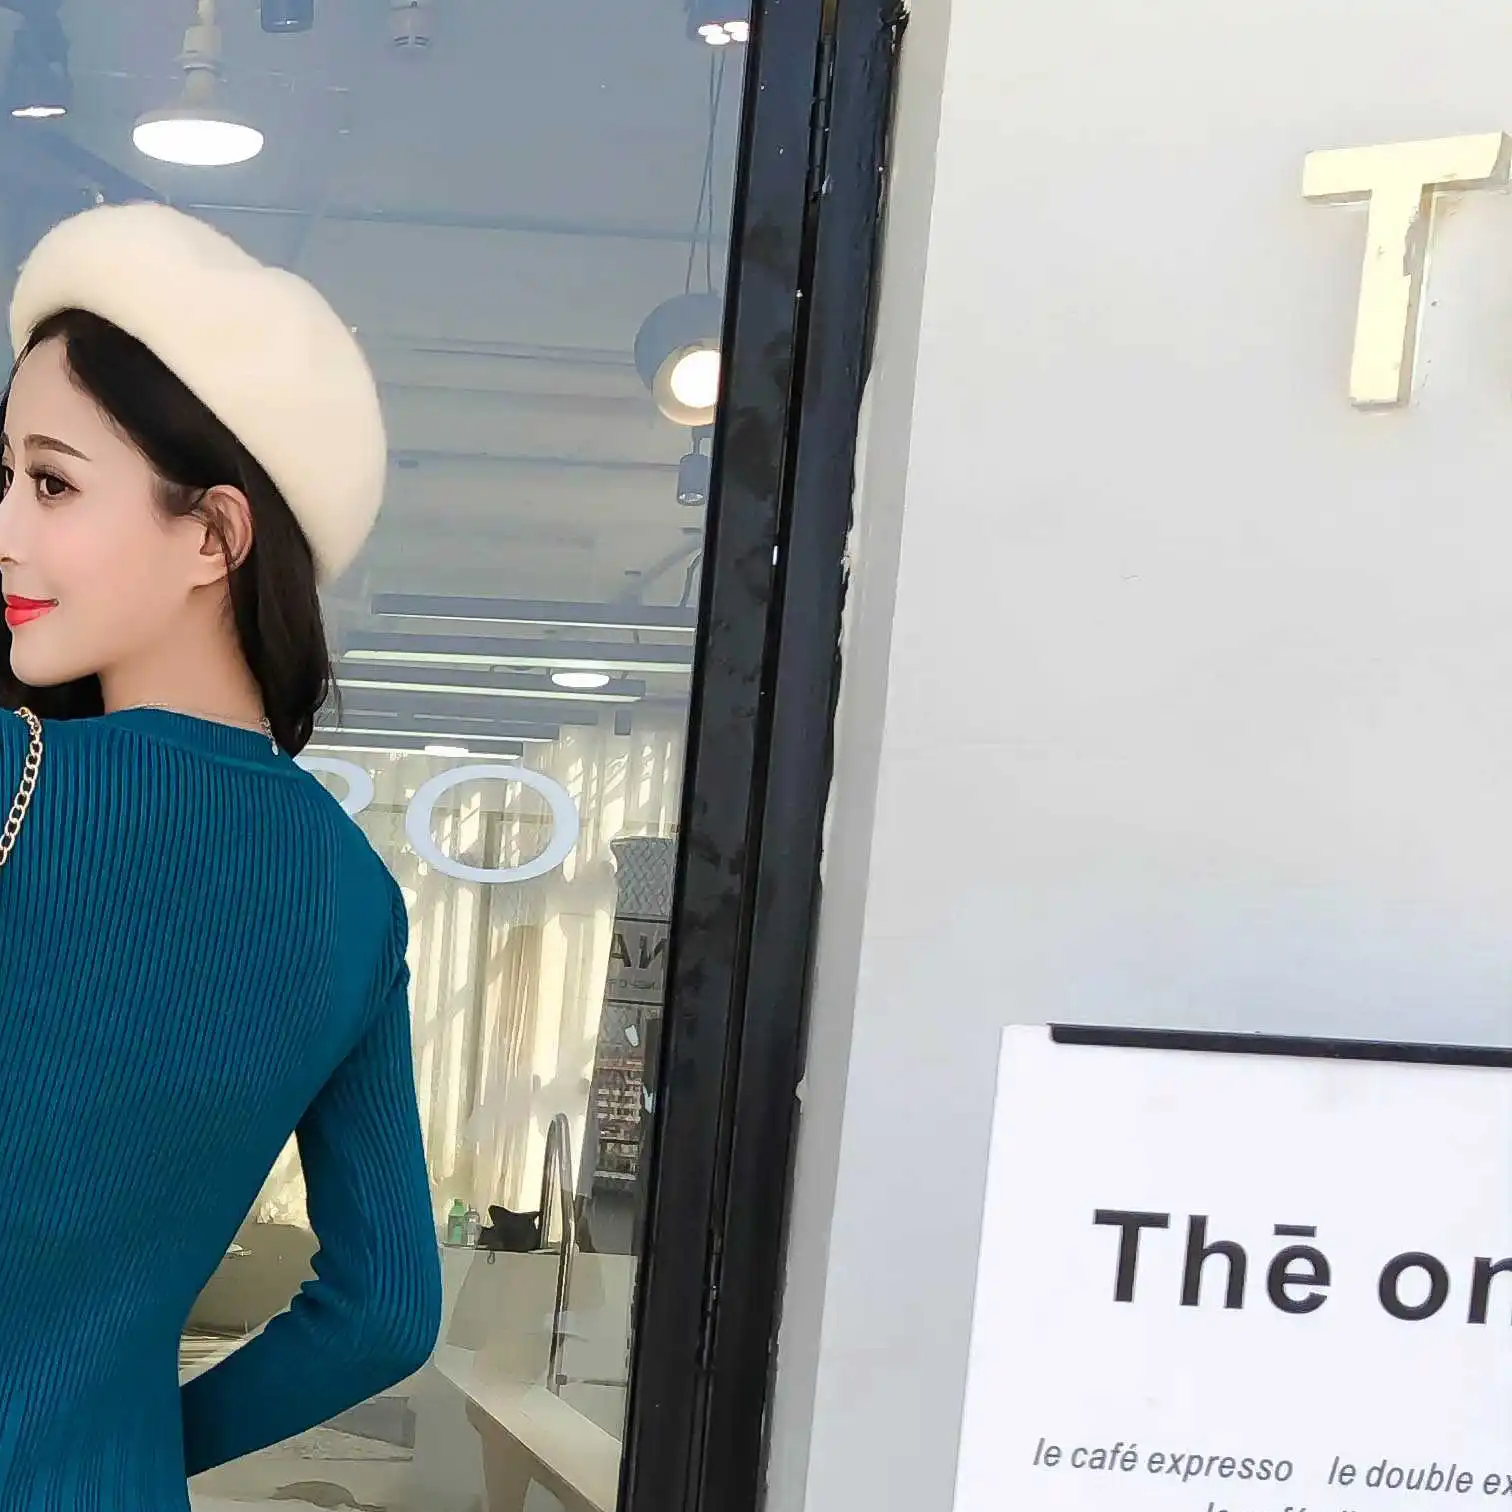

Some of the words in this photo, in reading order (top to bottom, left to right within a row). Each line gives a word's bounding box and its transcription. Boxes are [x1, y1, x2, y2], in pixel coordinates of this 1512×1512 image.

[1300, 131, 1506, 408] T
[1033, 1437, 1061, 1467] le
[1071, 1443, 1139, 1472] café
[1147, 1452, 1294, 1483] expresso
[1328, 1455, 1357, 1486] le
[1366, 1459, 1473, 1494] double
